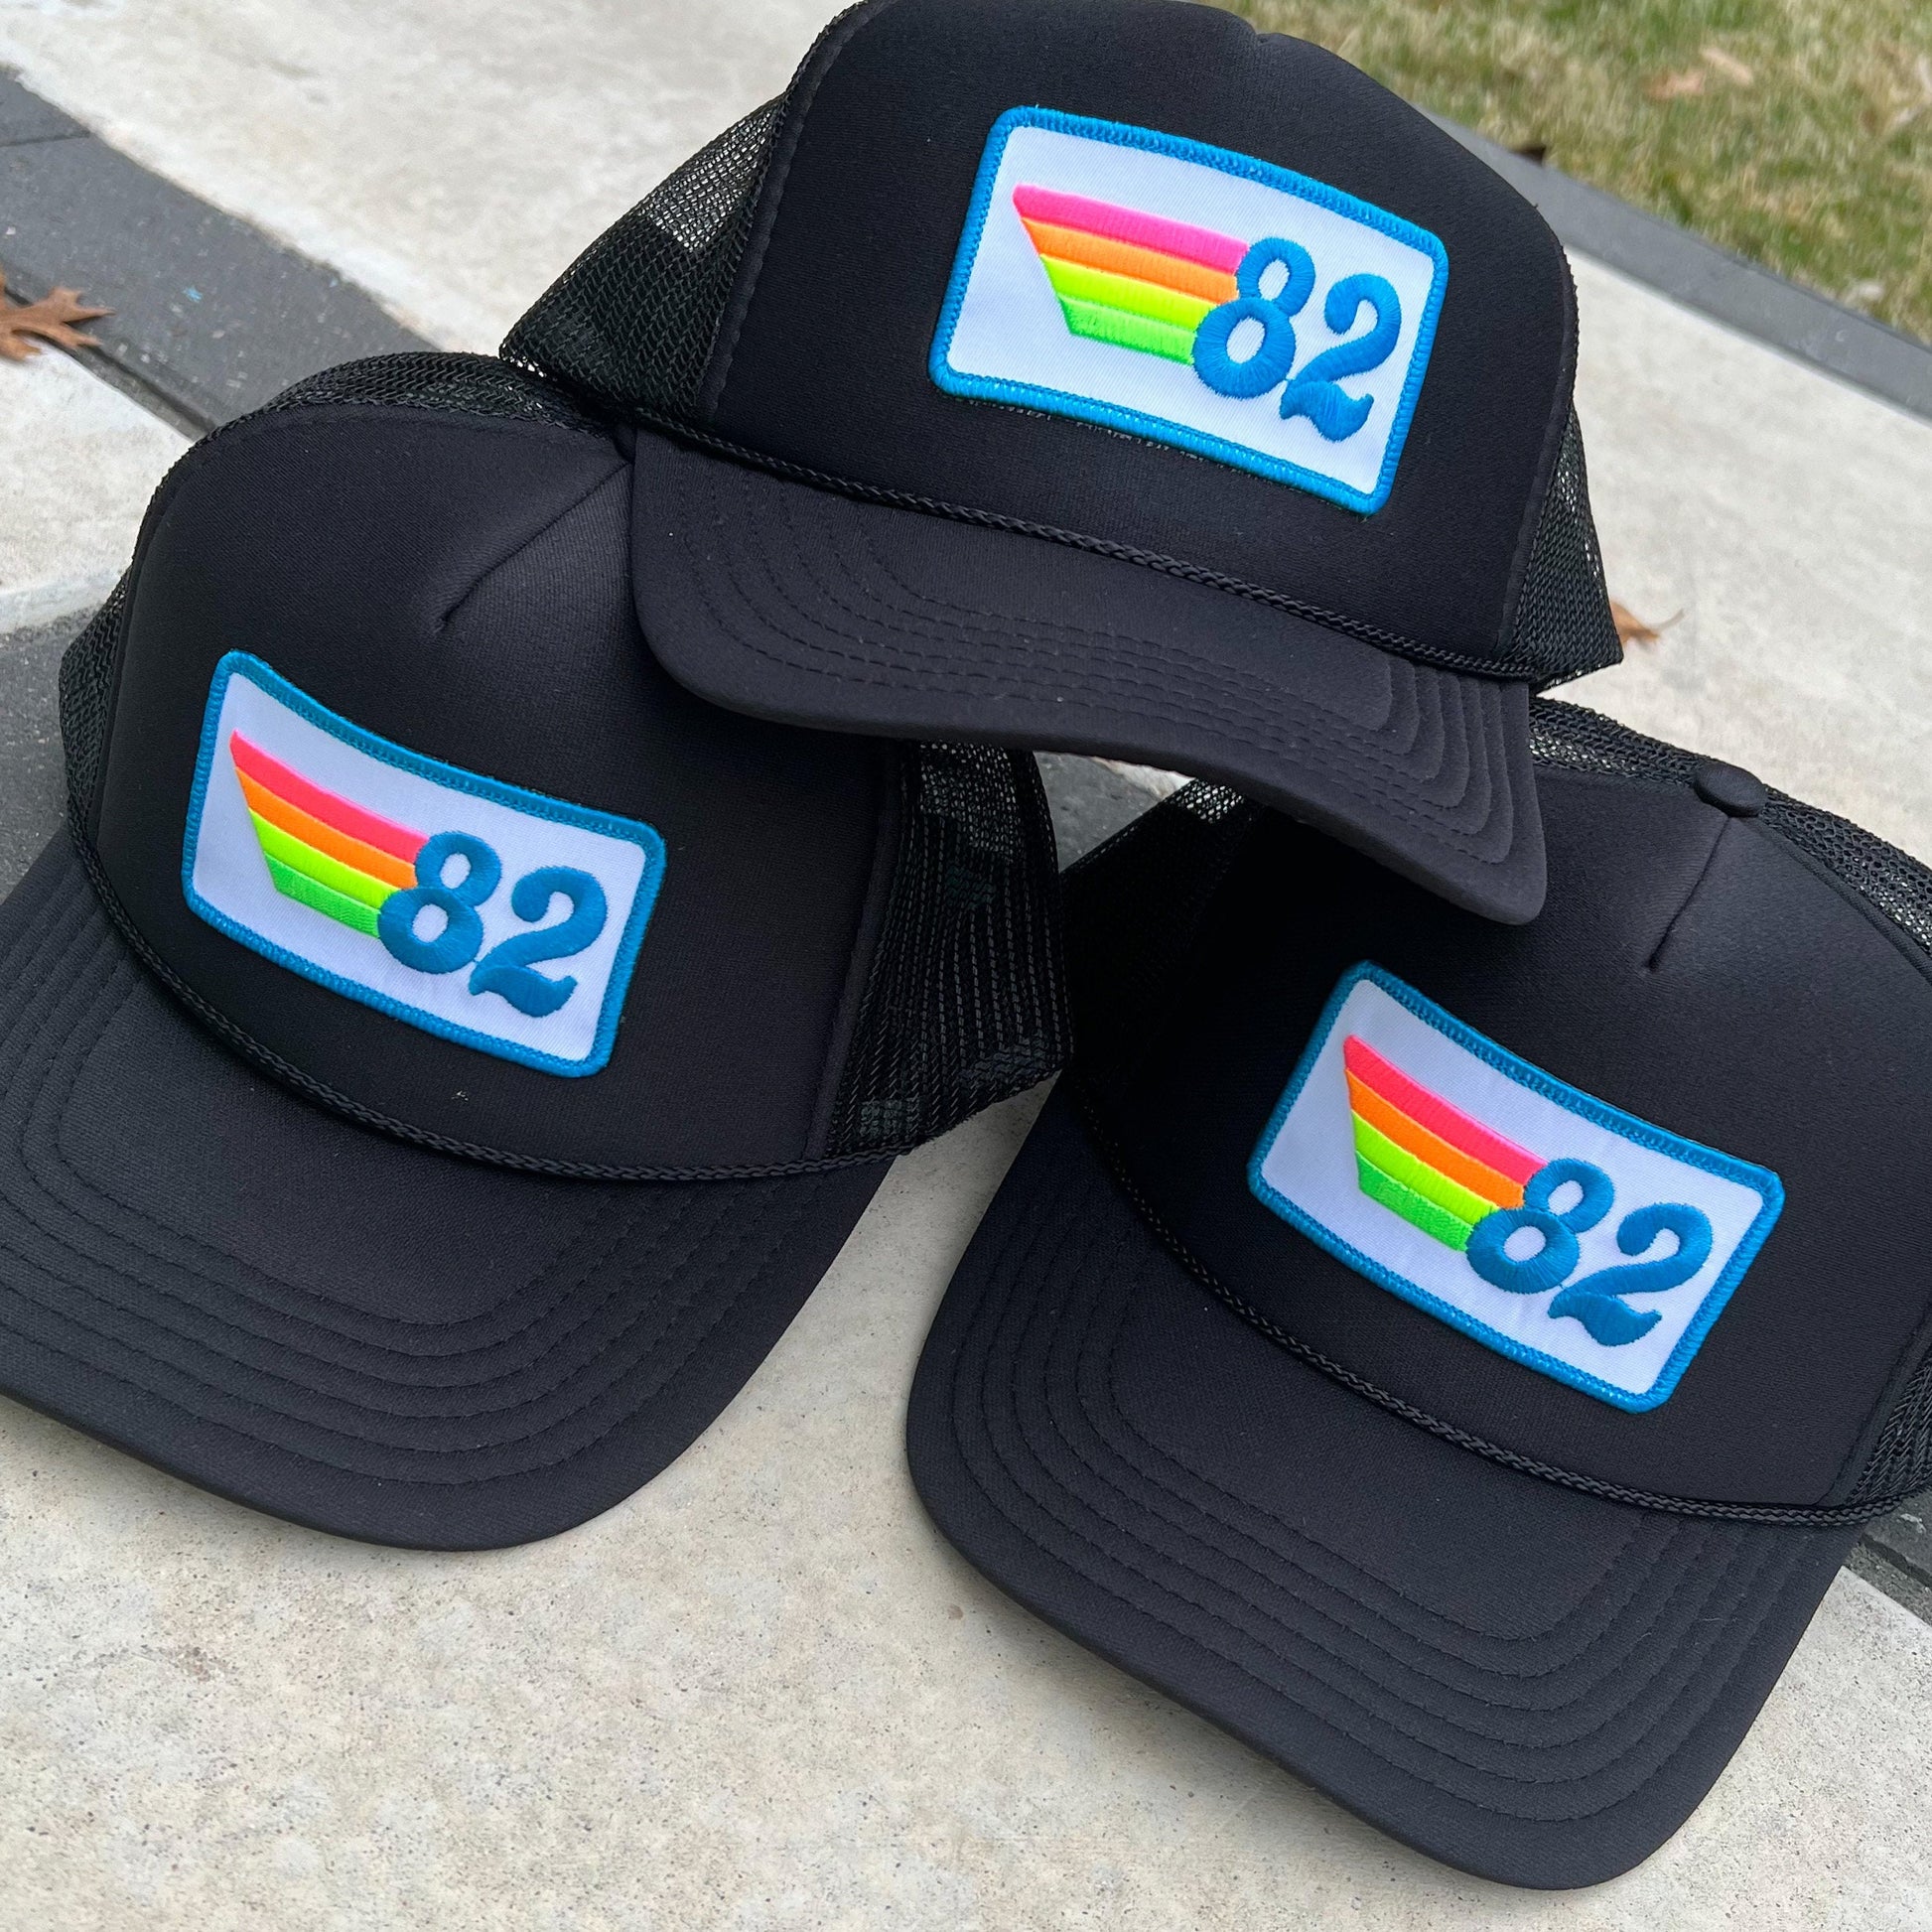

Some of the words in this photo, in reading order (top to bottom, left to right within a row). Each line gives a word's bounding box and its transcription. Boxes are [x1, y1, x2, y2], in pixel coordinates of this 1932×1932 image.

[1192, 236, 1402, 442] 82
[378, 831, 608, 1019] 82
[1465, 1158, 1713, 1346] 82
